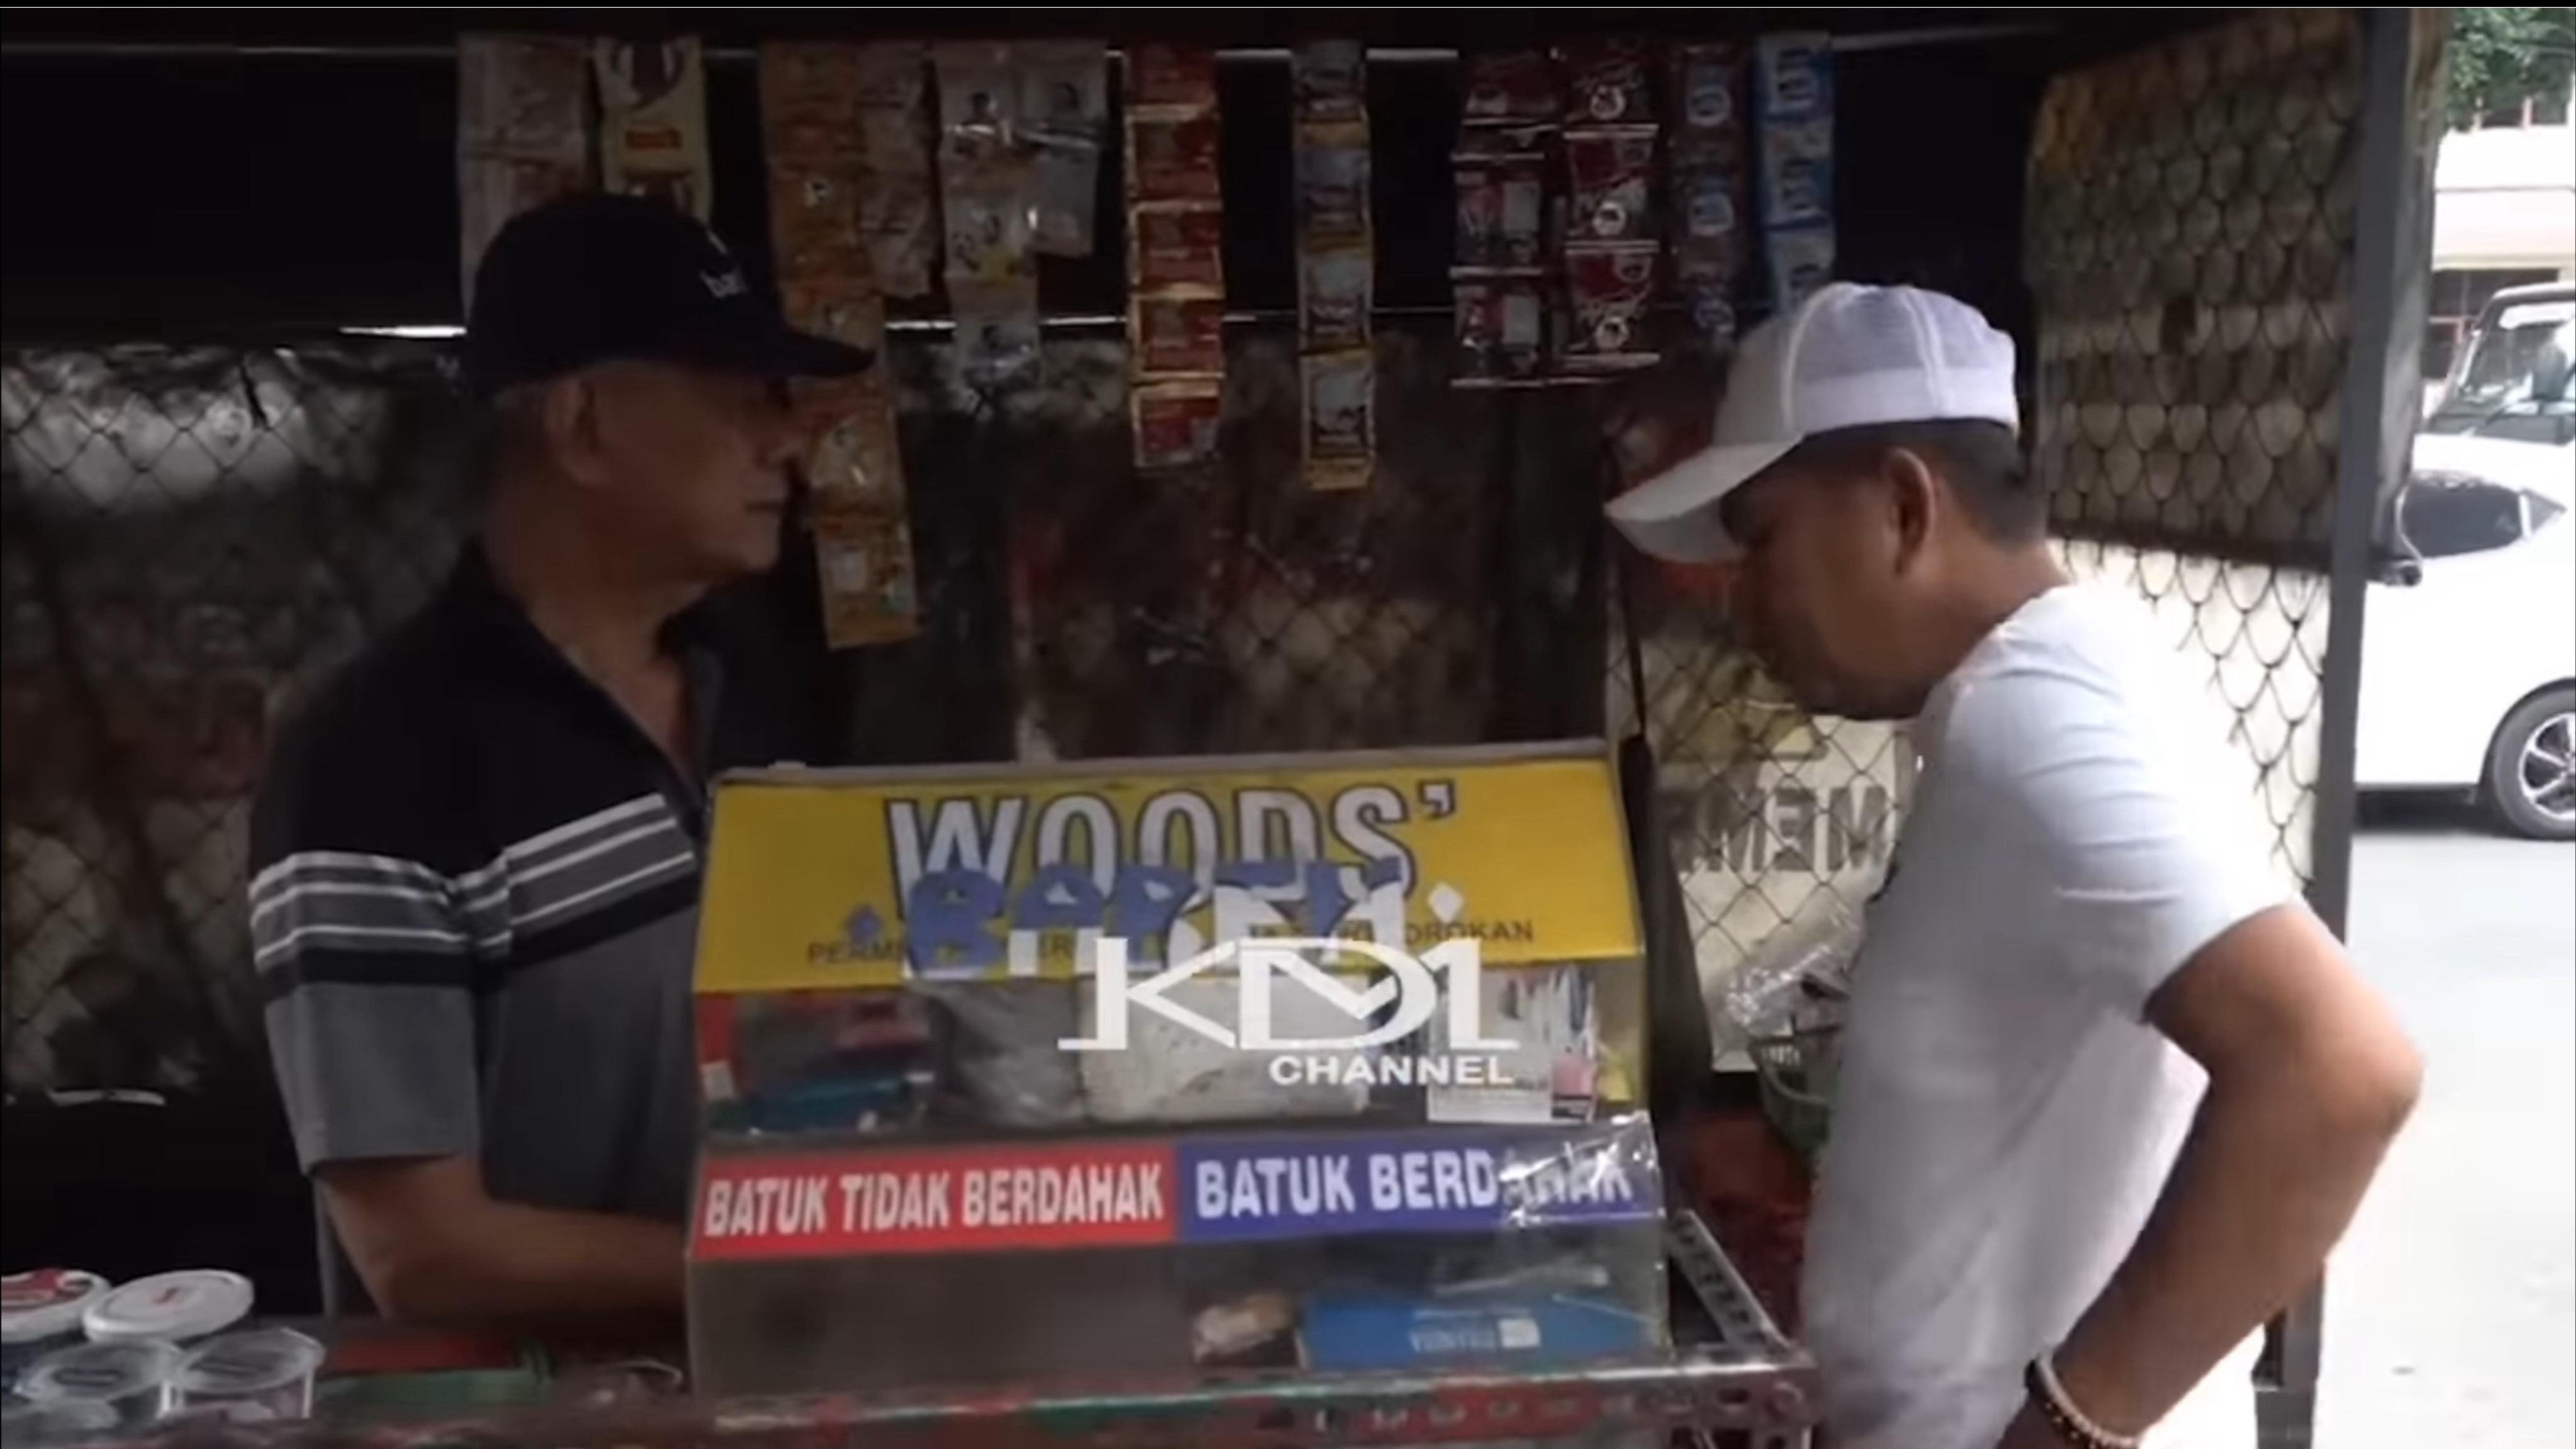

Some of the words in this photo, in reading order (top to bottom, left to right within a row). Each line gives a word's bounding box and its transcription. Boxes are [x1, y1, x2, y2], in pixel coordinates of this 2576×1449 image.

[703, 1175, 829, 1238] BATUK
[839, 1171, 951, 1233] TIDAK
[961, 1161, 1165, 1228] BERDAHAK
[1195, 1153, 1357, 1219] BATUK
